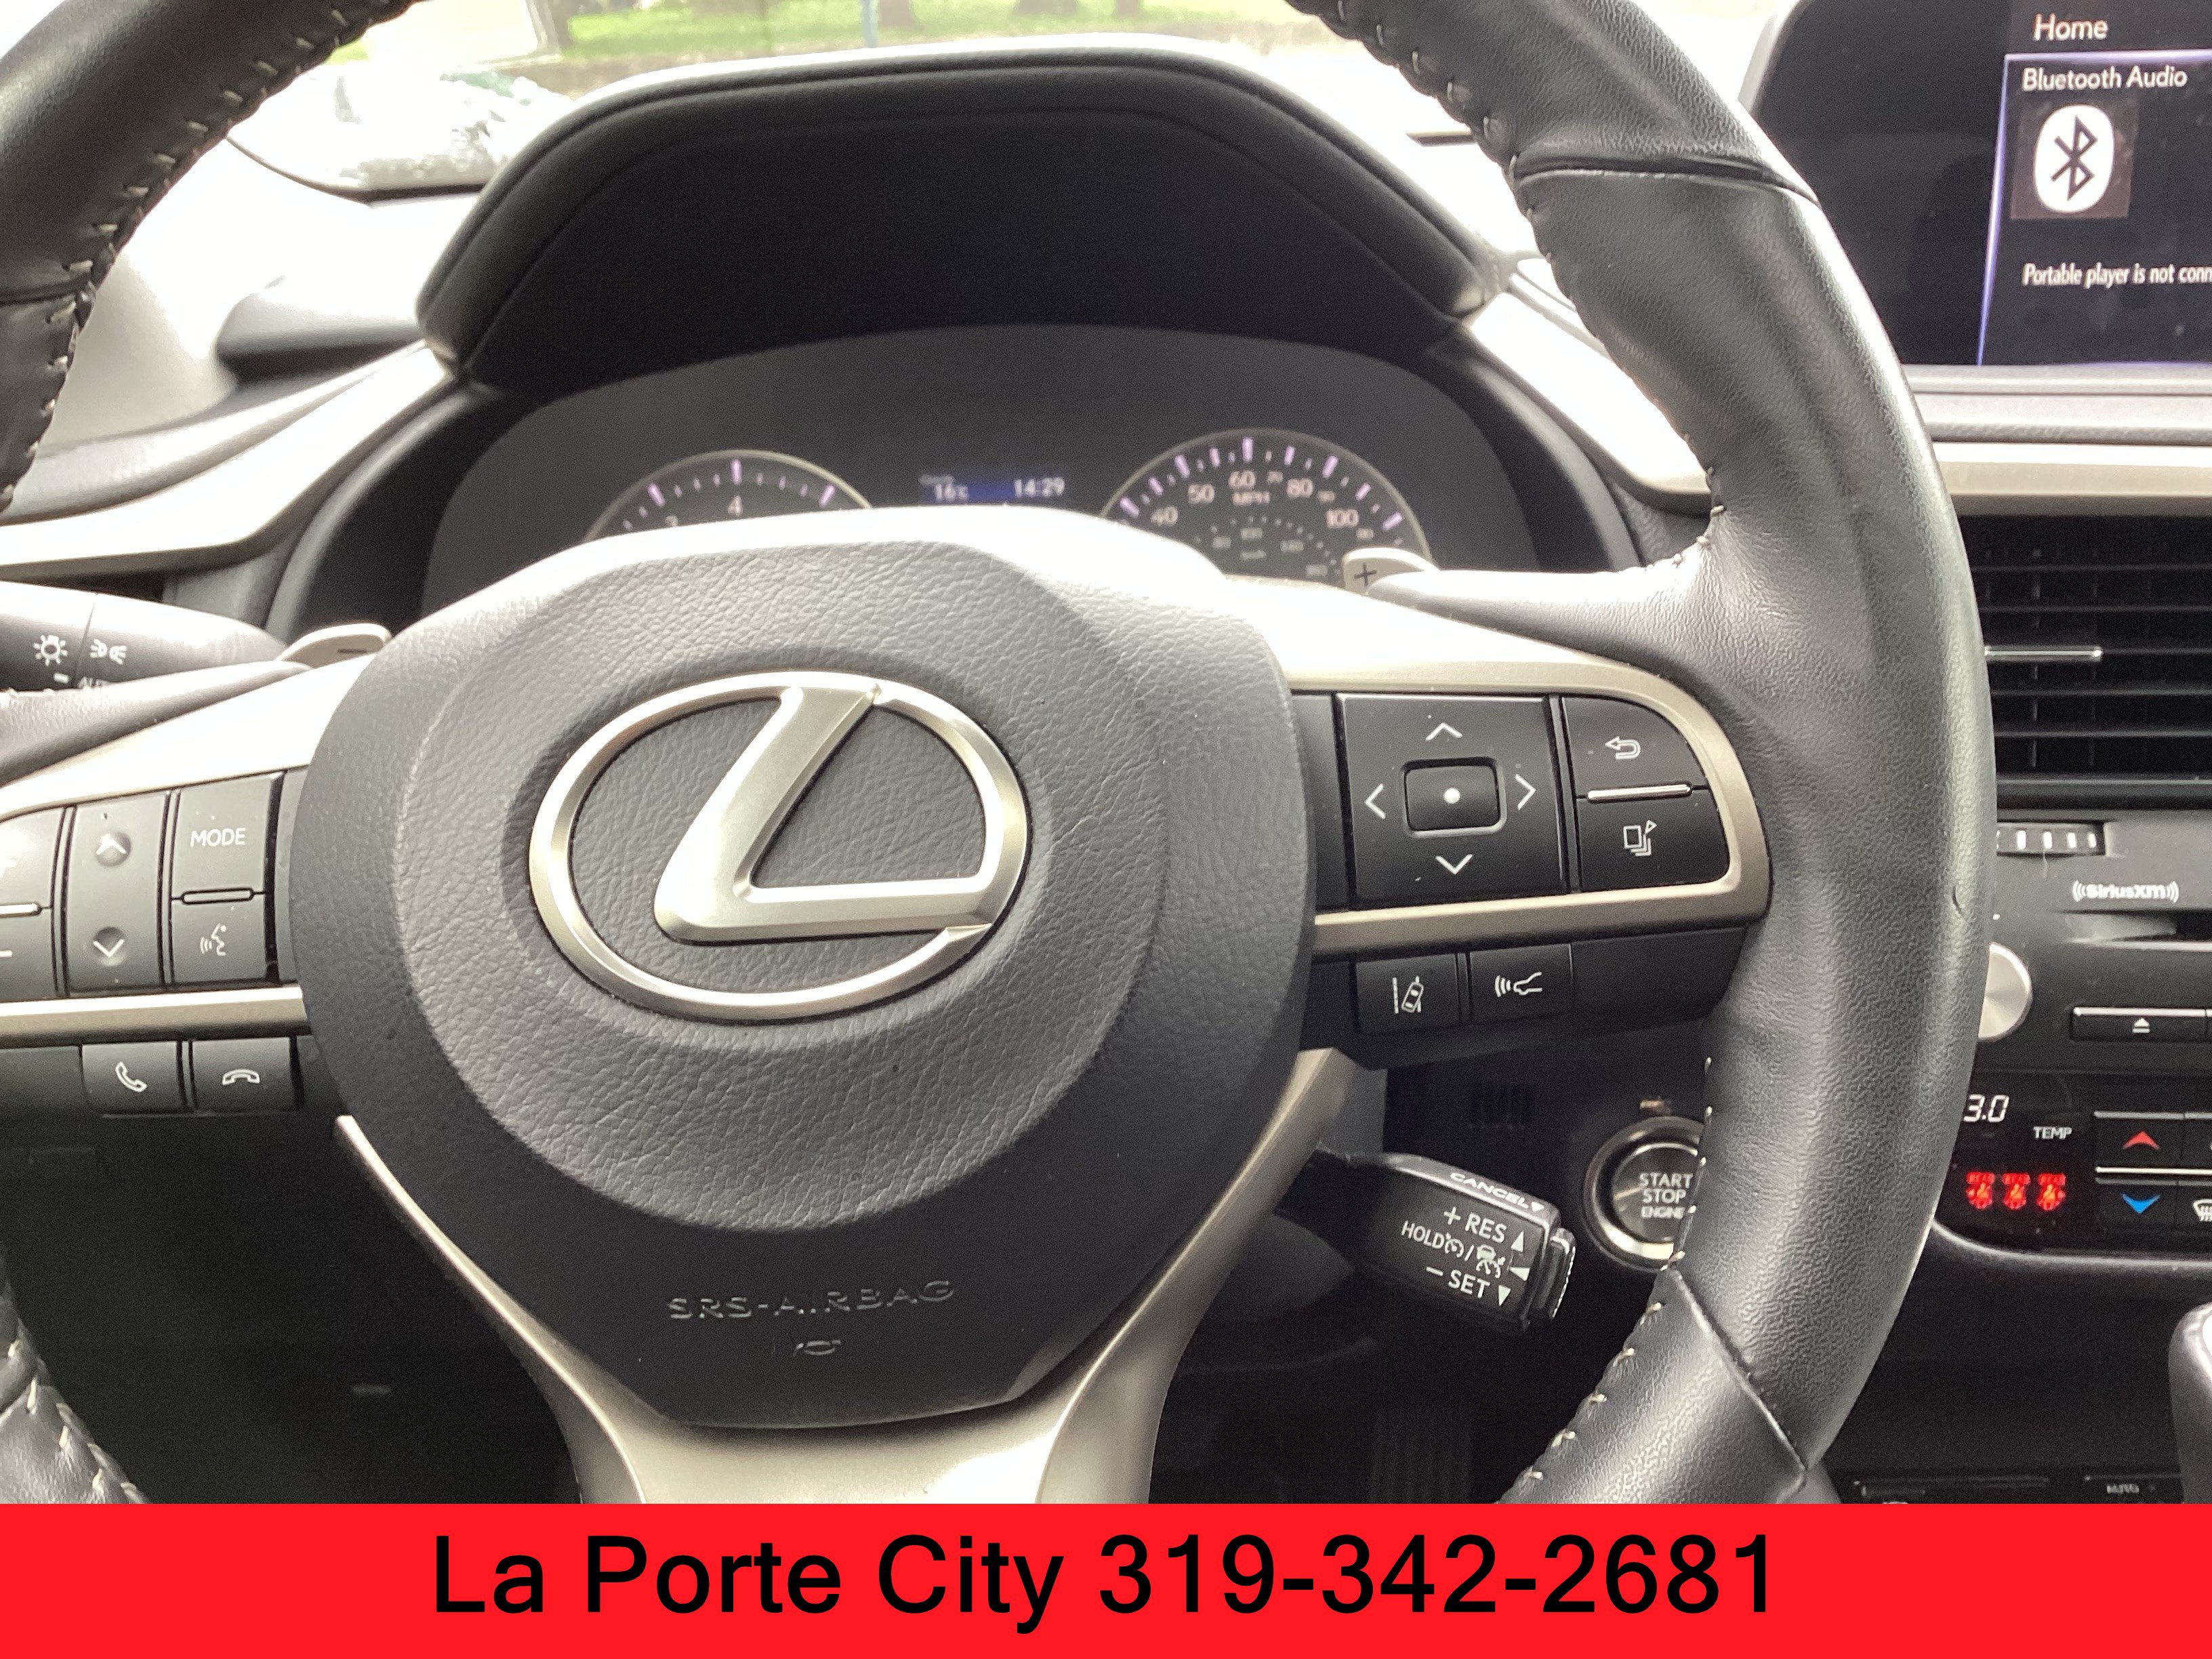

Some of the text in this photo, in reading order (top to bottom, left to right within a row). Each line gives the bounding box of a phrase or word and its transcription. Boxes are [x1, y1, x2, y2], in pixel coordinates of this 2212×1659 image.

[2034, 13, 2108, 41] Home
[2022, 65, 2188, 91] Bluetooth Audio
[2022, 262, 2082, 286] Portable
[2083, 262, 2130, 289] player
[2133, 262, 2146, 284] is
[2150, 264, 2175, 284] not
[1228, 470, 1256, 489] 60
[1187, 483, 1215, 504] 50
[727, 495, 743, 516] 4
[1151, 506, 1179, 527] 40
[1325, 508, 1359, 529] 100
[189, 827, 247, 847] MODE
[2033, 1126, 2072, 1140] TEMP
[1450, 1172, 1529, 1209] CANCEL
[1639, 1172, 1694, 1188] START
[1642, 1188, 1687, 1204] STOP
[1401, 1220, 1446, 1249] HOLD
[1465, 1211, 1507, 1244] RES
[1448, 1269, 1490, 1298] SET
